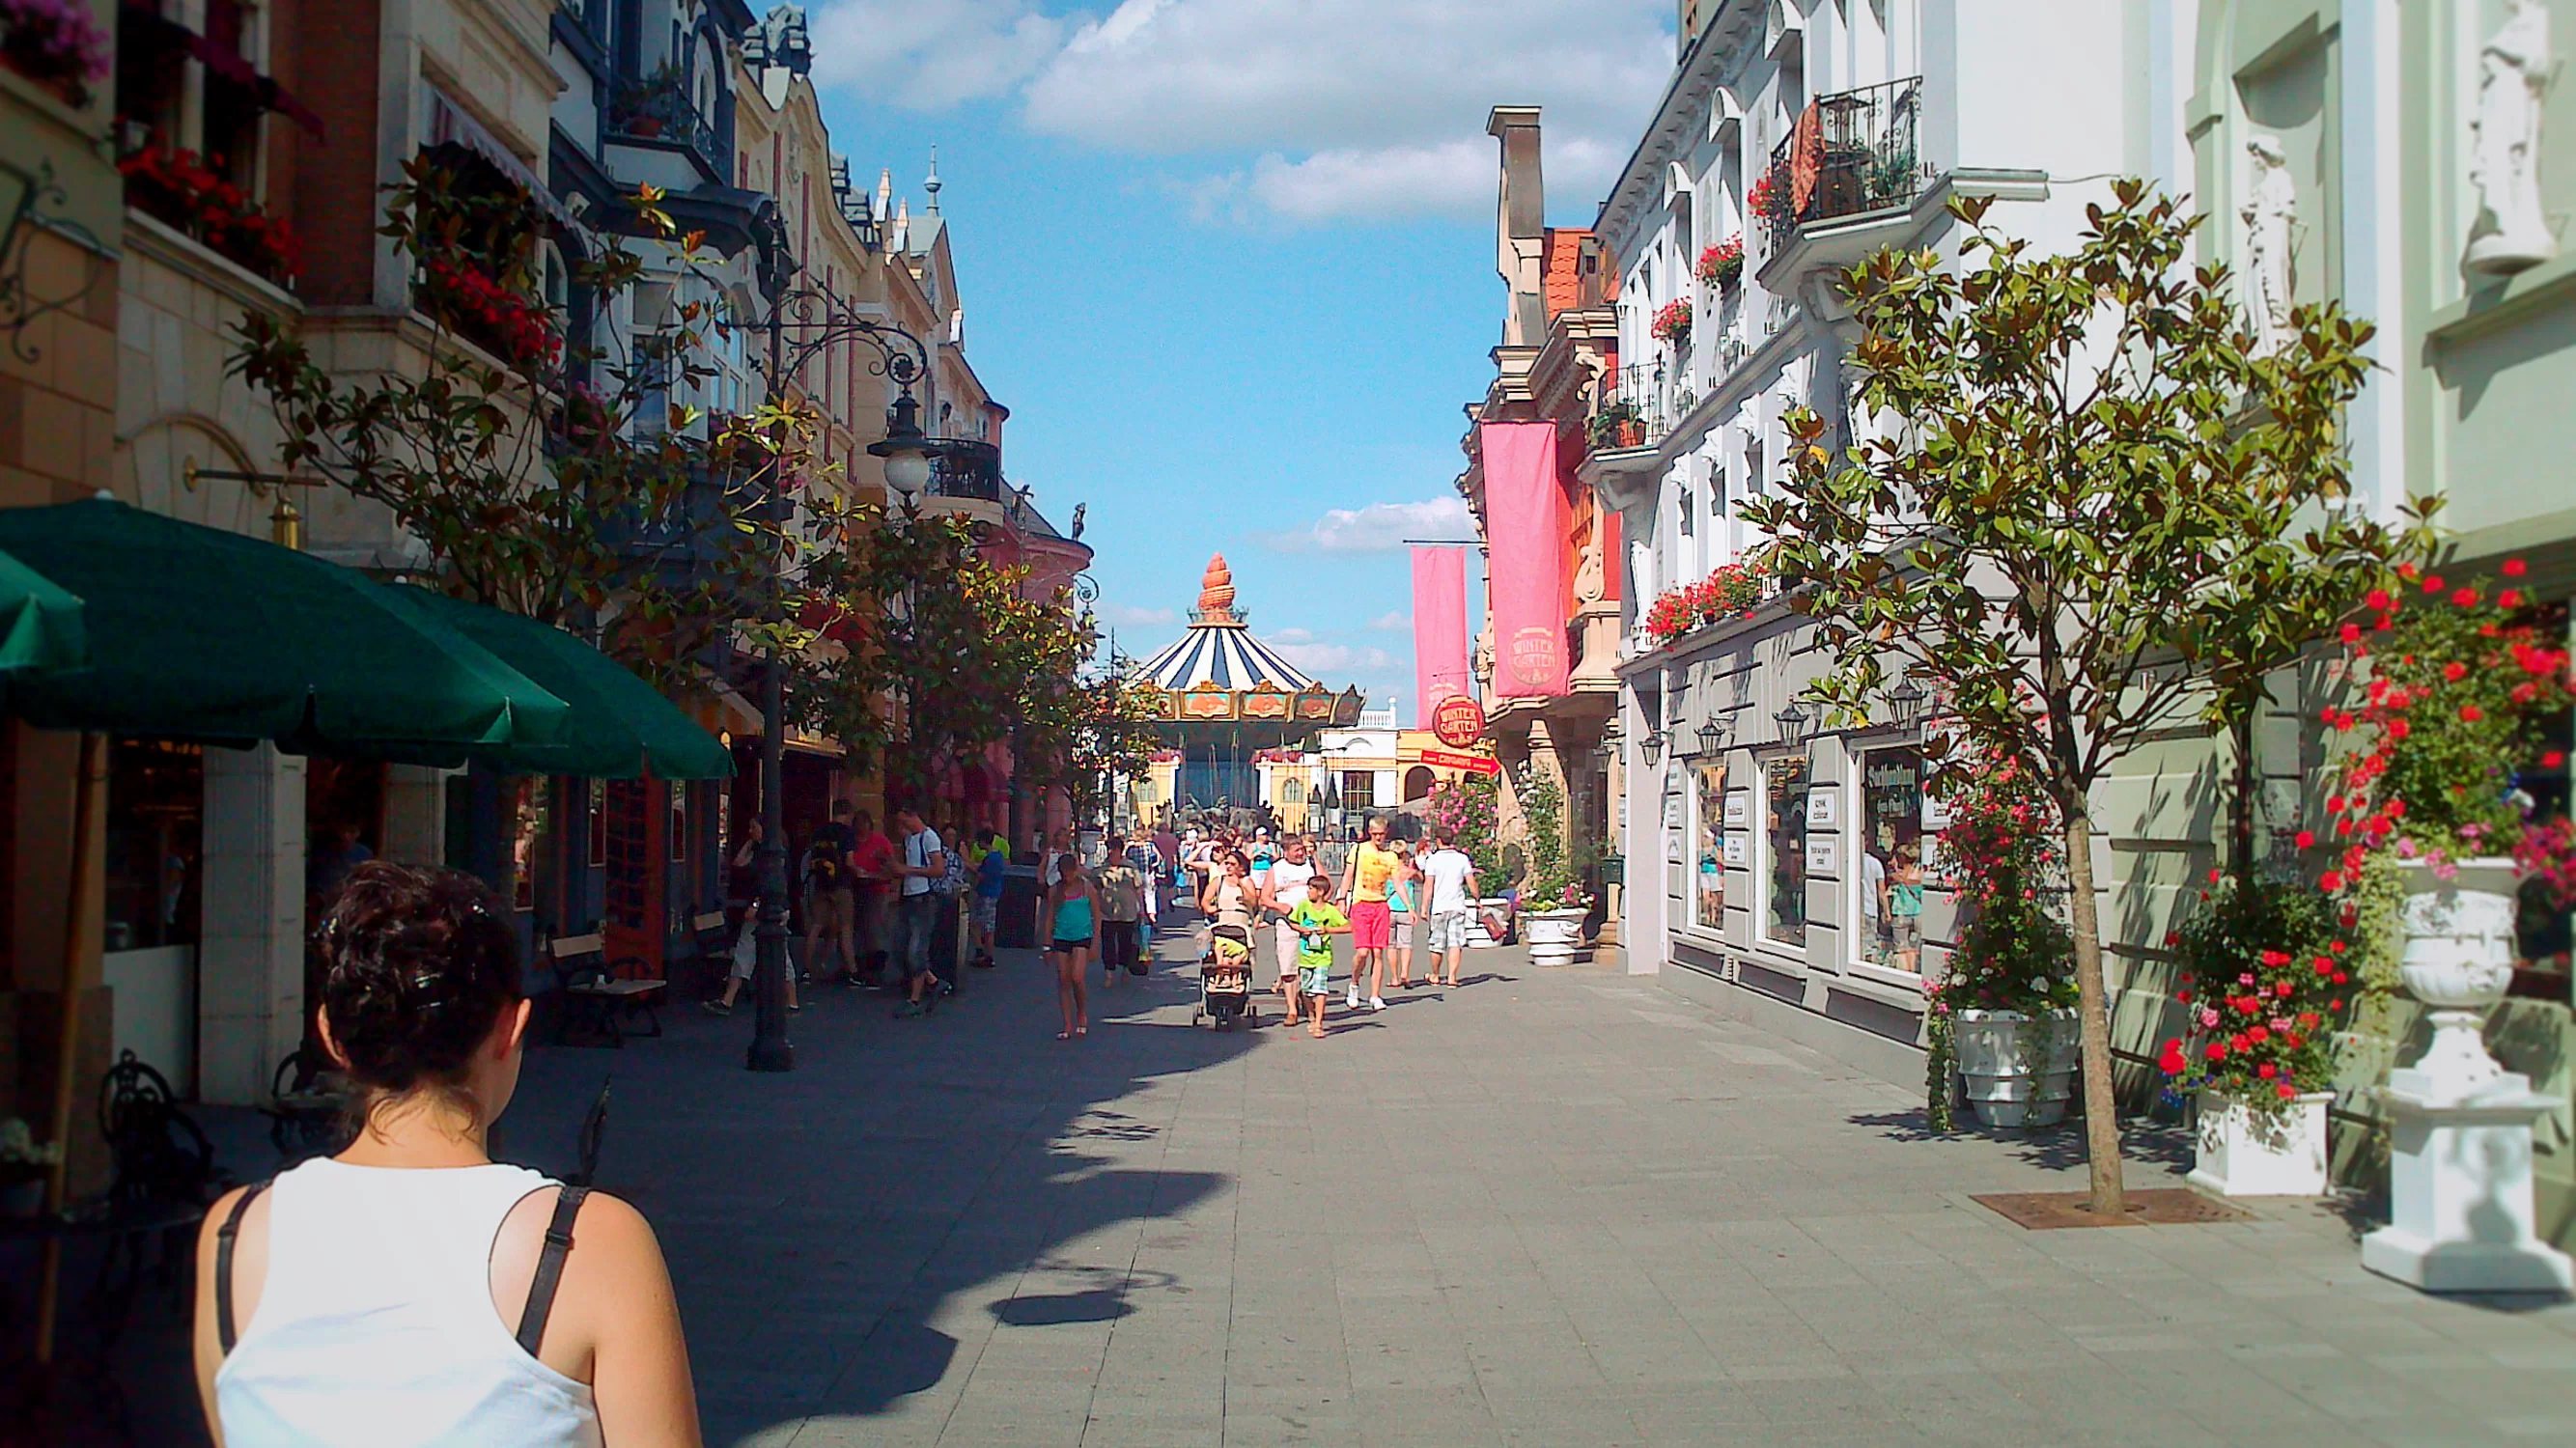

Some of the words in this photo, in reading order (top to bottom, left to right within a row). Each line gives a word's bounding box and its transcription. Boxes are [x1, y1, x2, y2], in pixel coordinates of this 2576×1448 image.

[1513, 639, 1554, 654] WINTER
[1513, 654, 1555, 667] GARTEN
[1440, 708, 1475, 723] WINTER
[1441, 721, 1478, 734] GARTEN
